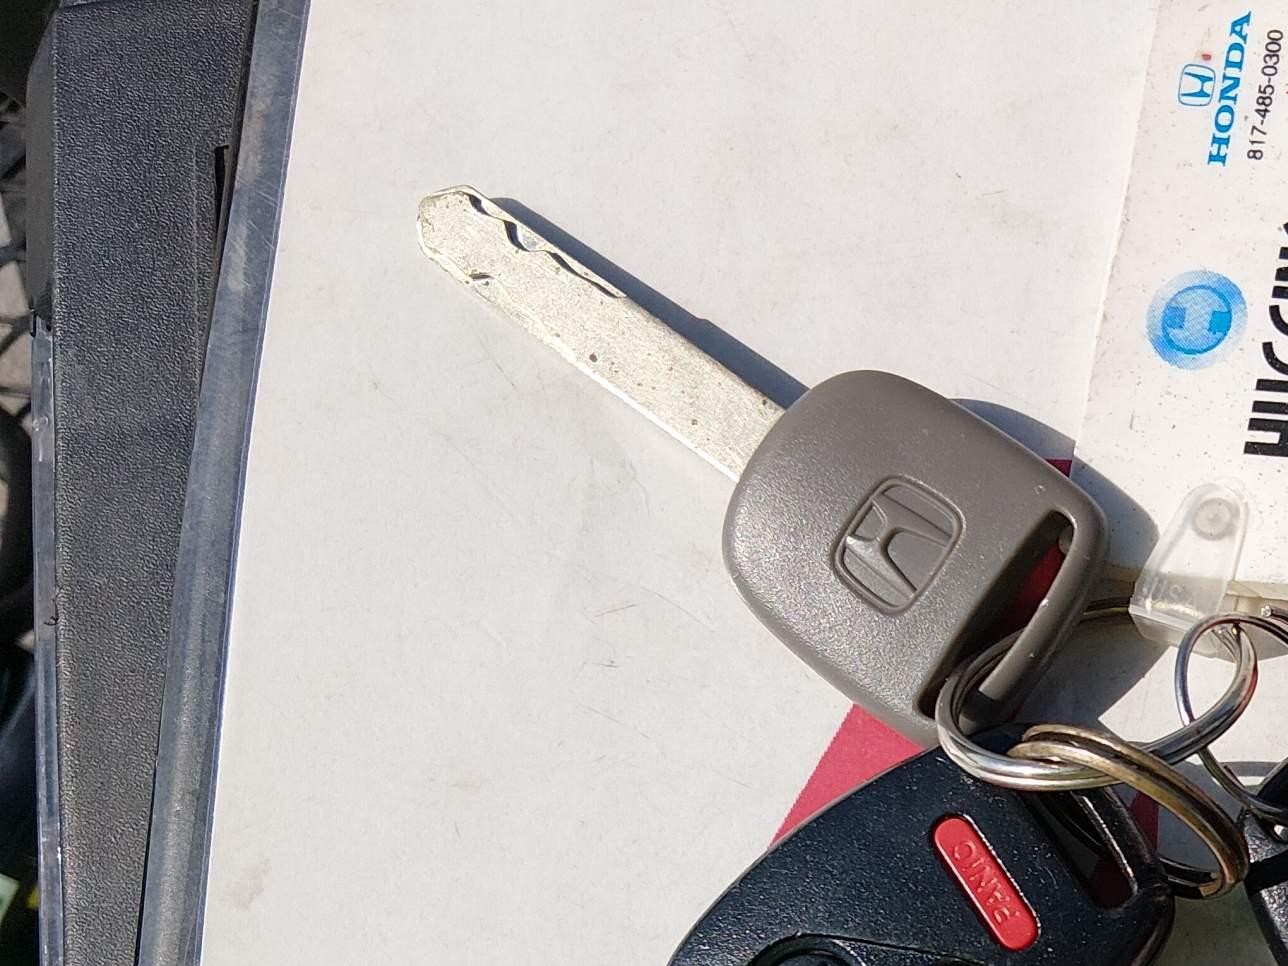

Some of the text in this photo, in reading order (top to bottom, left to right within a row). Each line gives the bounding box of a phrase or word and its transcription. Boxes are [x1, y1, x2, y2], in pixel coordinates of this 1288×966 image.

[1208, 11, 1251, 167] HONDA
[1247, 29, 1284, 161] 817-485-0300
[953, 840, 1021, 924] PANIC
